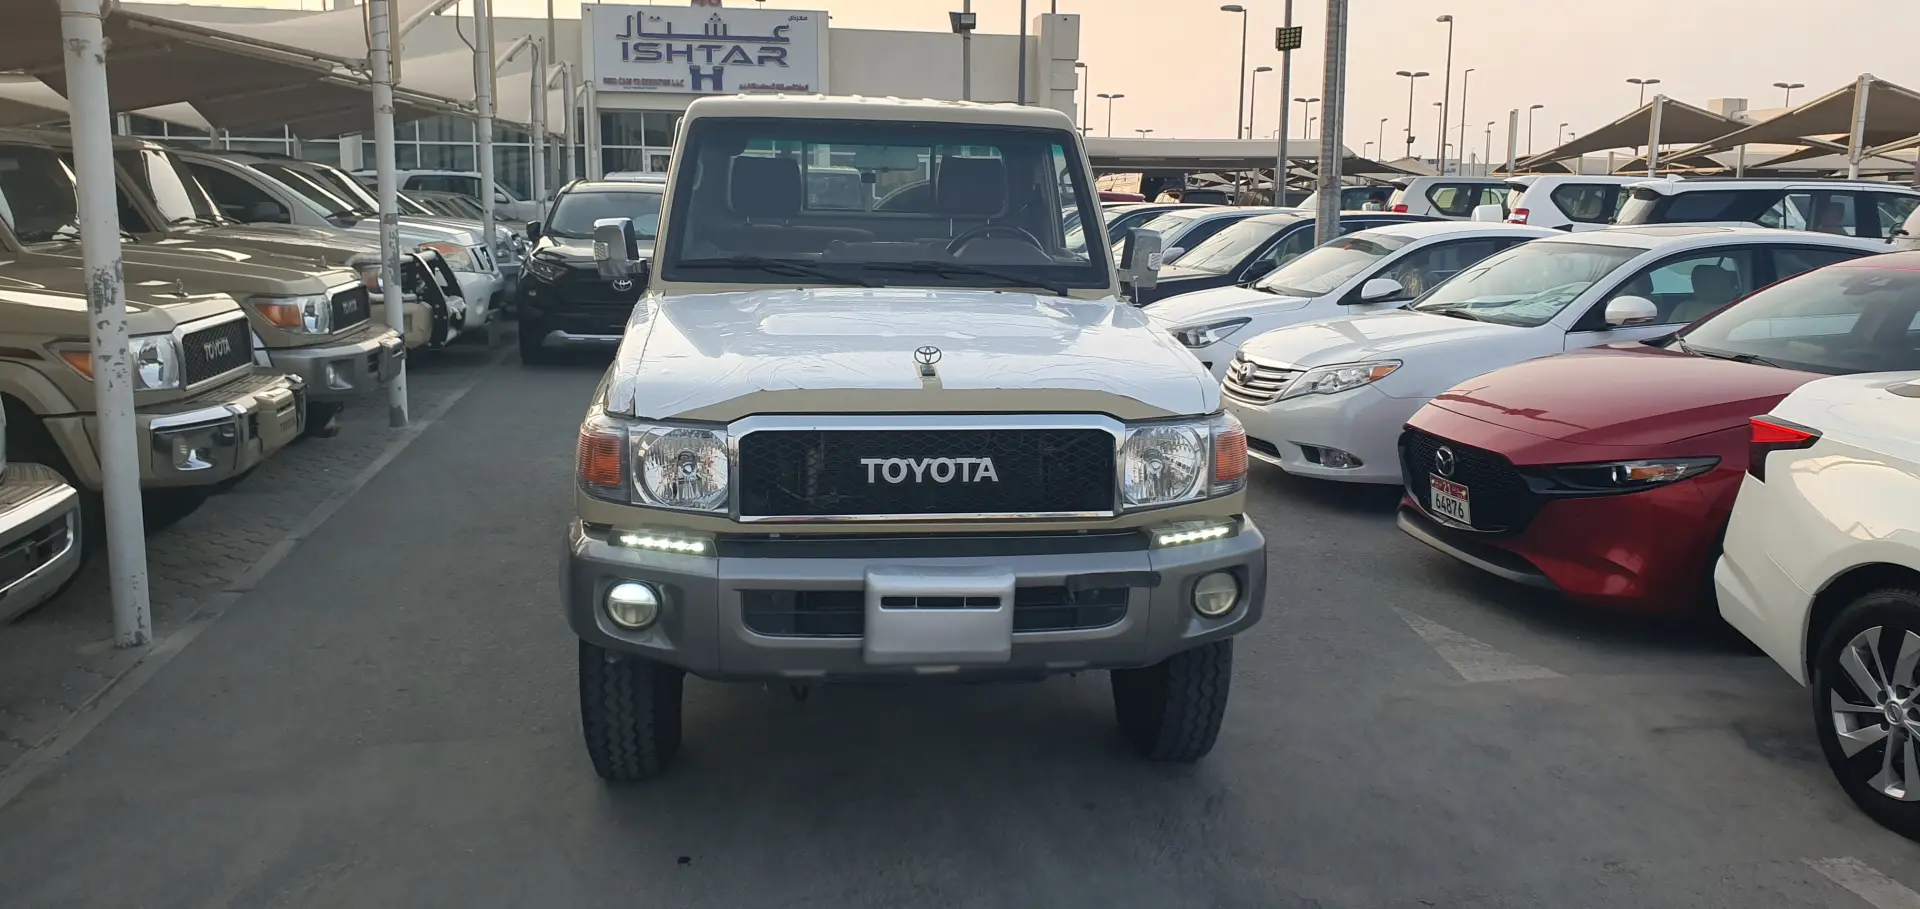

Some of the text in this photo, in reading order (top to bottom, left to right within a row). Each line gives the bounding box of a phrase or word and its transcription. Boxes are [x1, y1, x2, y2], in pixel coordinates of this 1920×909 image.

[622, 42, 789, 67] ISHTAR
[204, 338, 231, 361] TOYOTA
[860, 457, 999, 484] TOYOTA
[1442, 482, 1452, 495] 21
[1435, 494, 1465, 519] 64876
